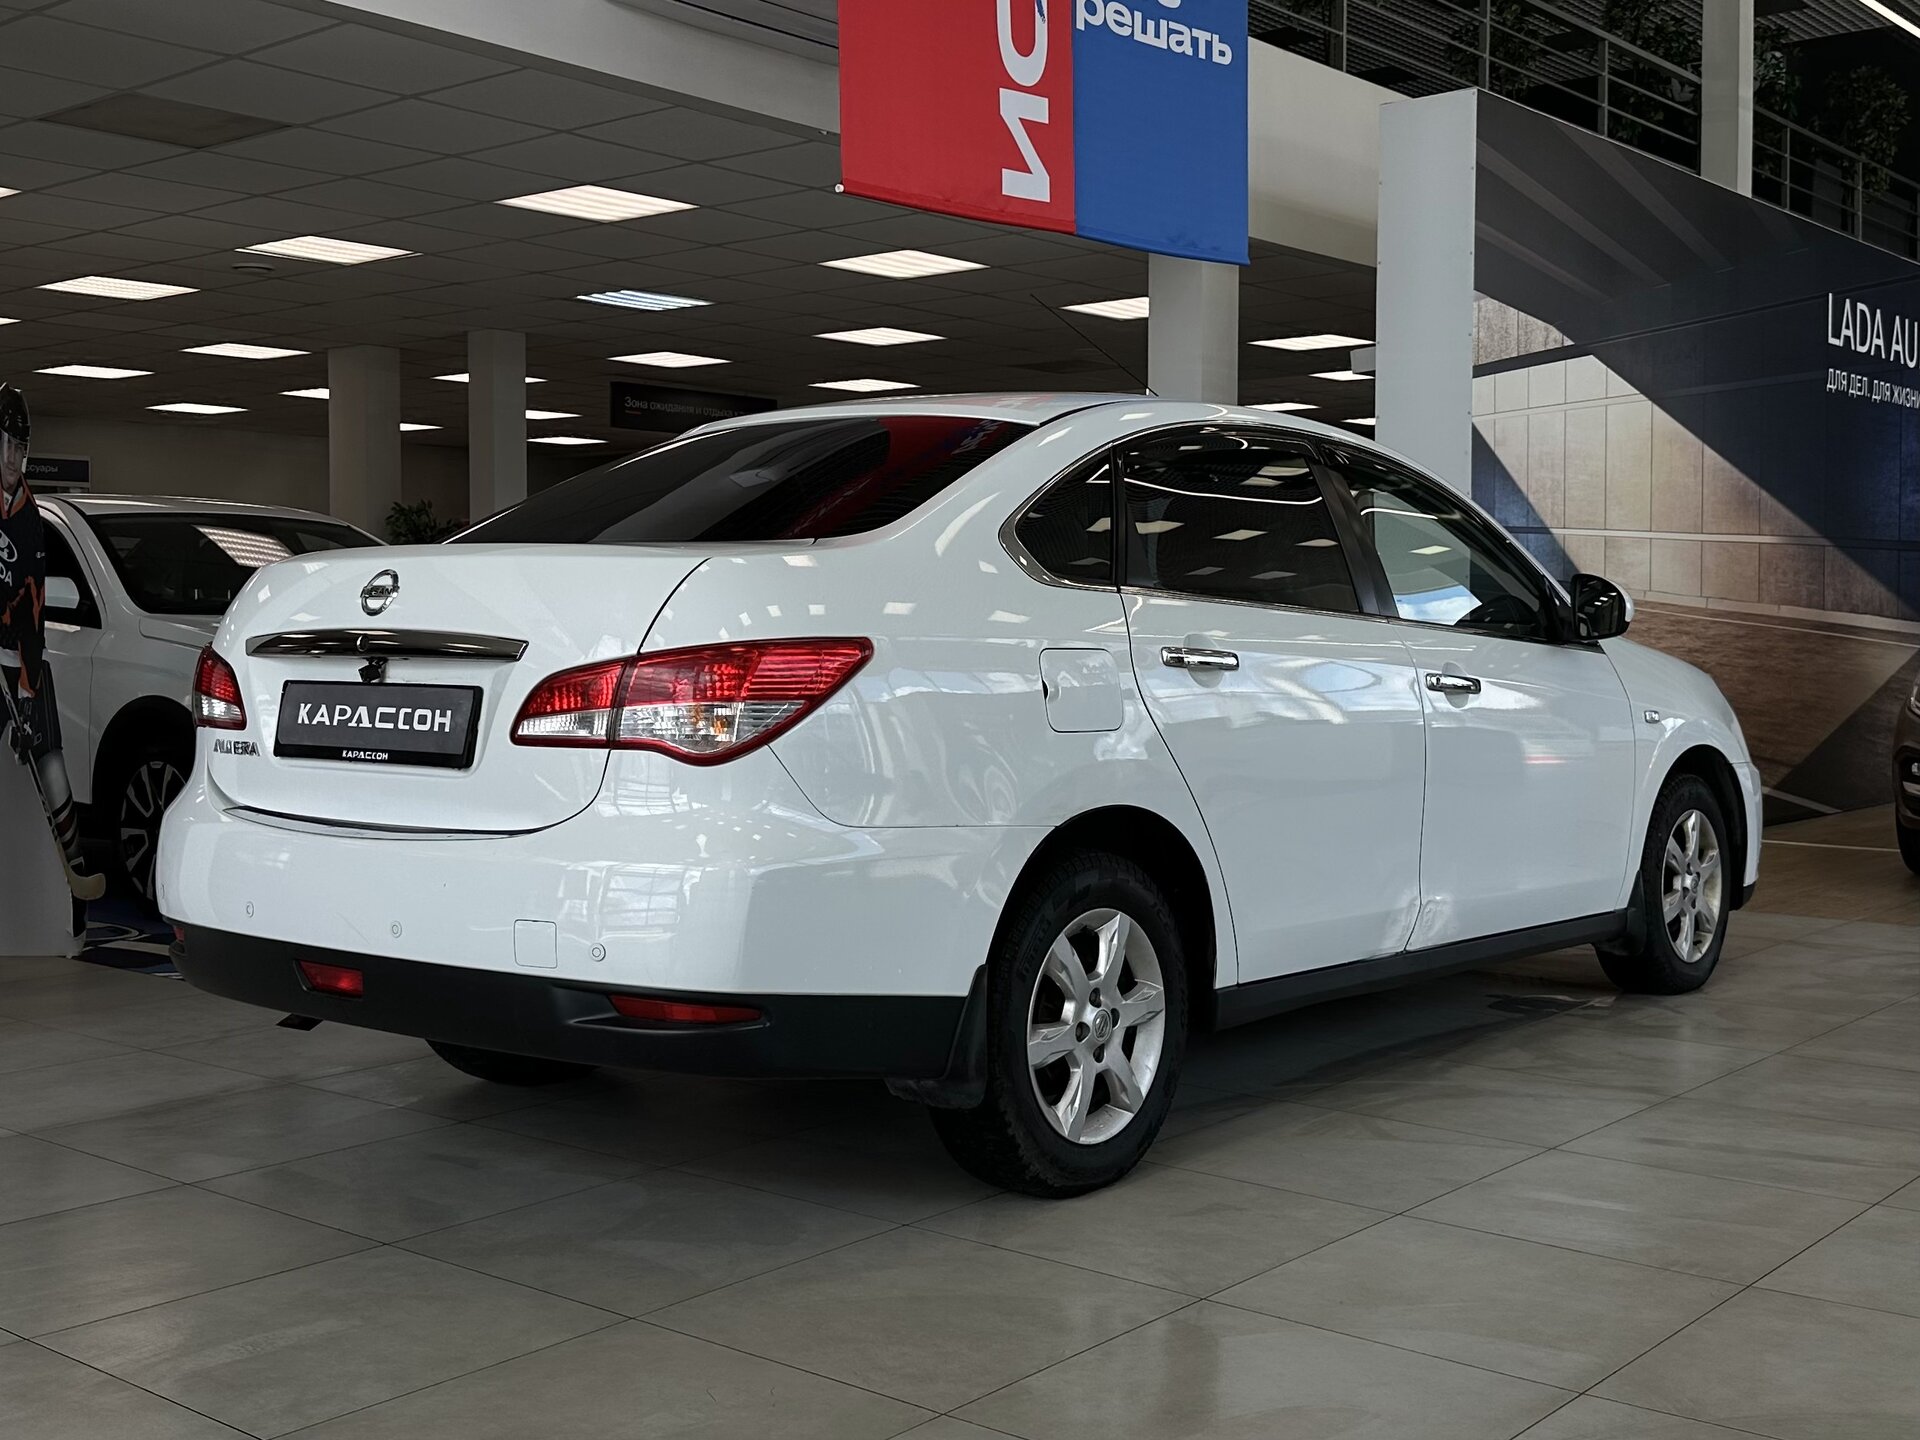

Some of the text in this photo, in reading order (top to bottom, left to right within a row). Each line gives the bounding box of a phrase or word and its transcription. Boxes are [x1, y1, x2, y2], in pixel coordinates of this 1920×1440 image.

[1075, 0, 1233, 66] решать
[1828, 292, 1920, 369] LADA AU
[1827, 368, 1848, 393] ДЛЯ
[1848, 374, 1871, 398] ДЕЛ.
[1871, 380, 1891, 404] ДЛЯ
[624, 396, 648, 409] Зона
[649, 401, 695, 414] ожидания
[297, 702, 452, 733] КАРАССОН
[342, 749, 389, 761] КАРАССОН
